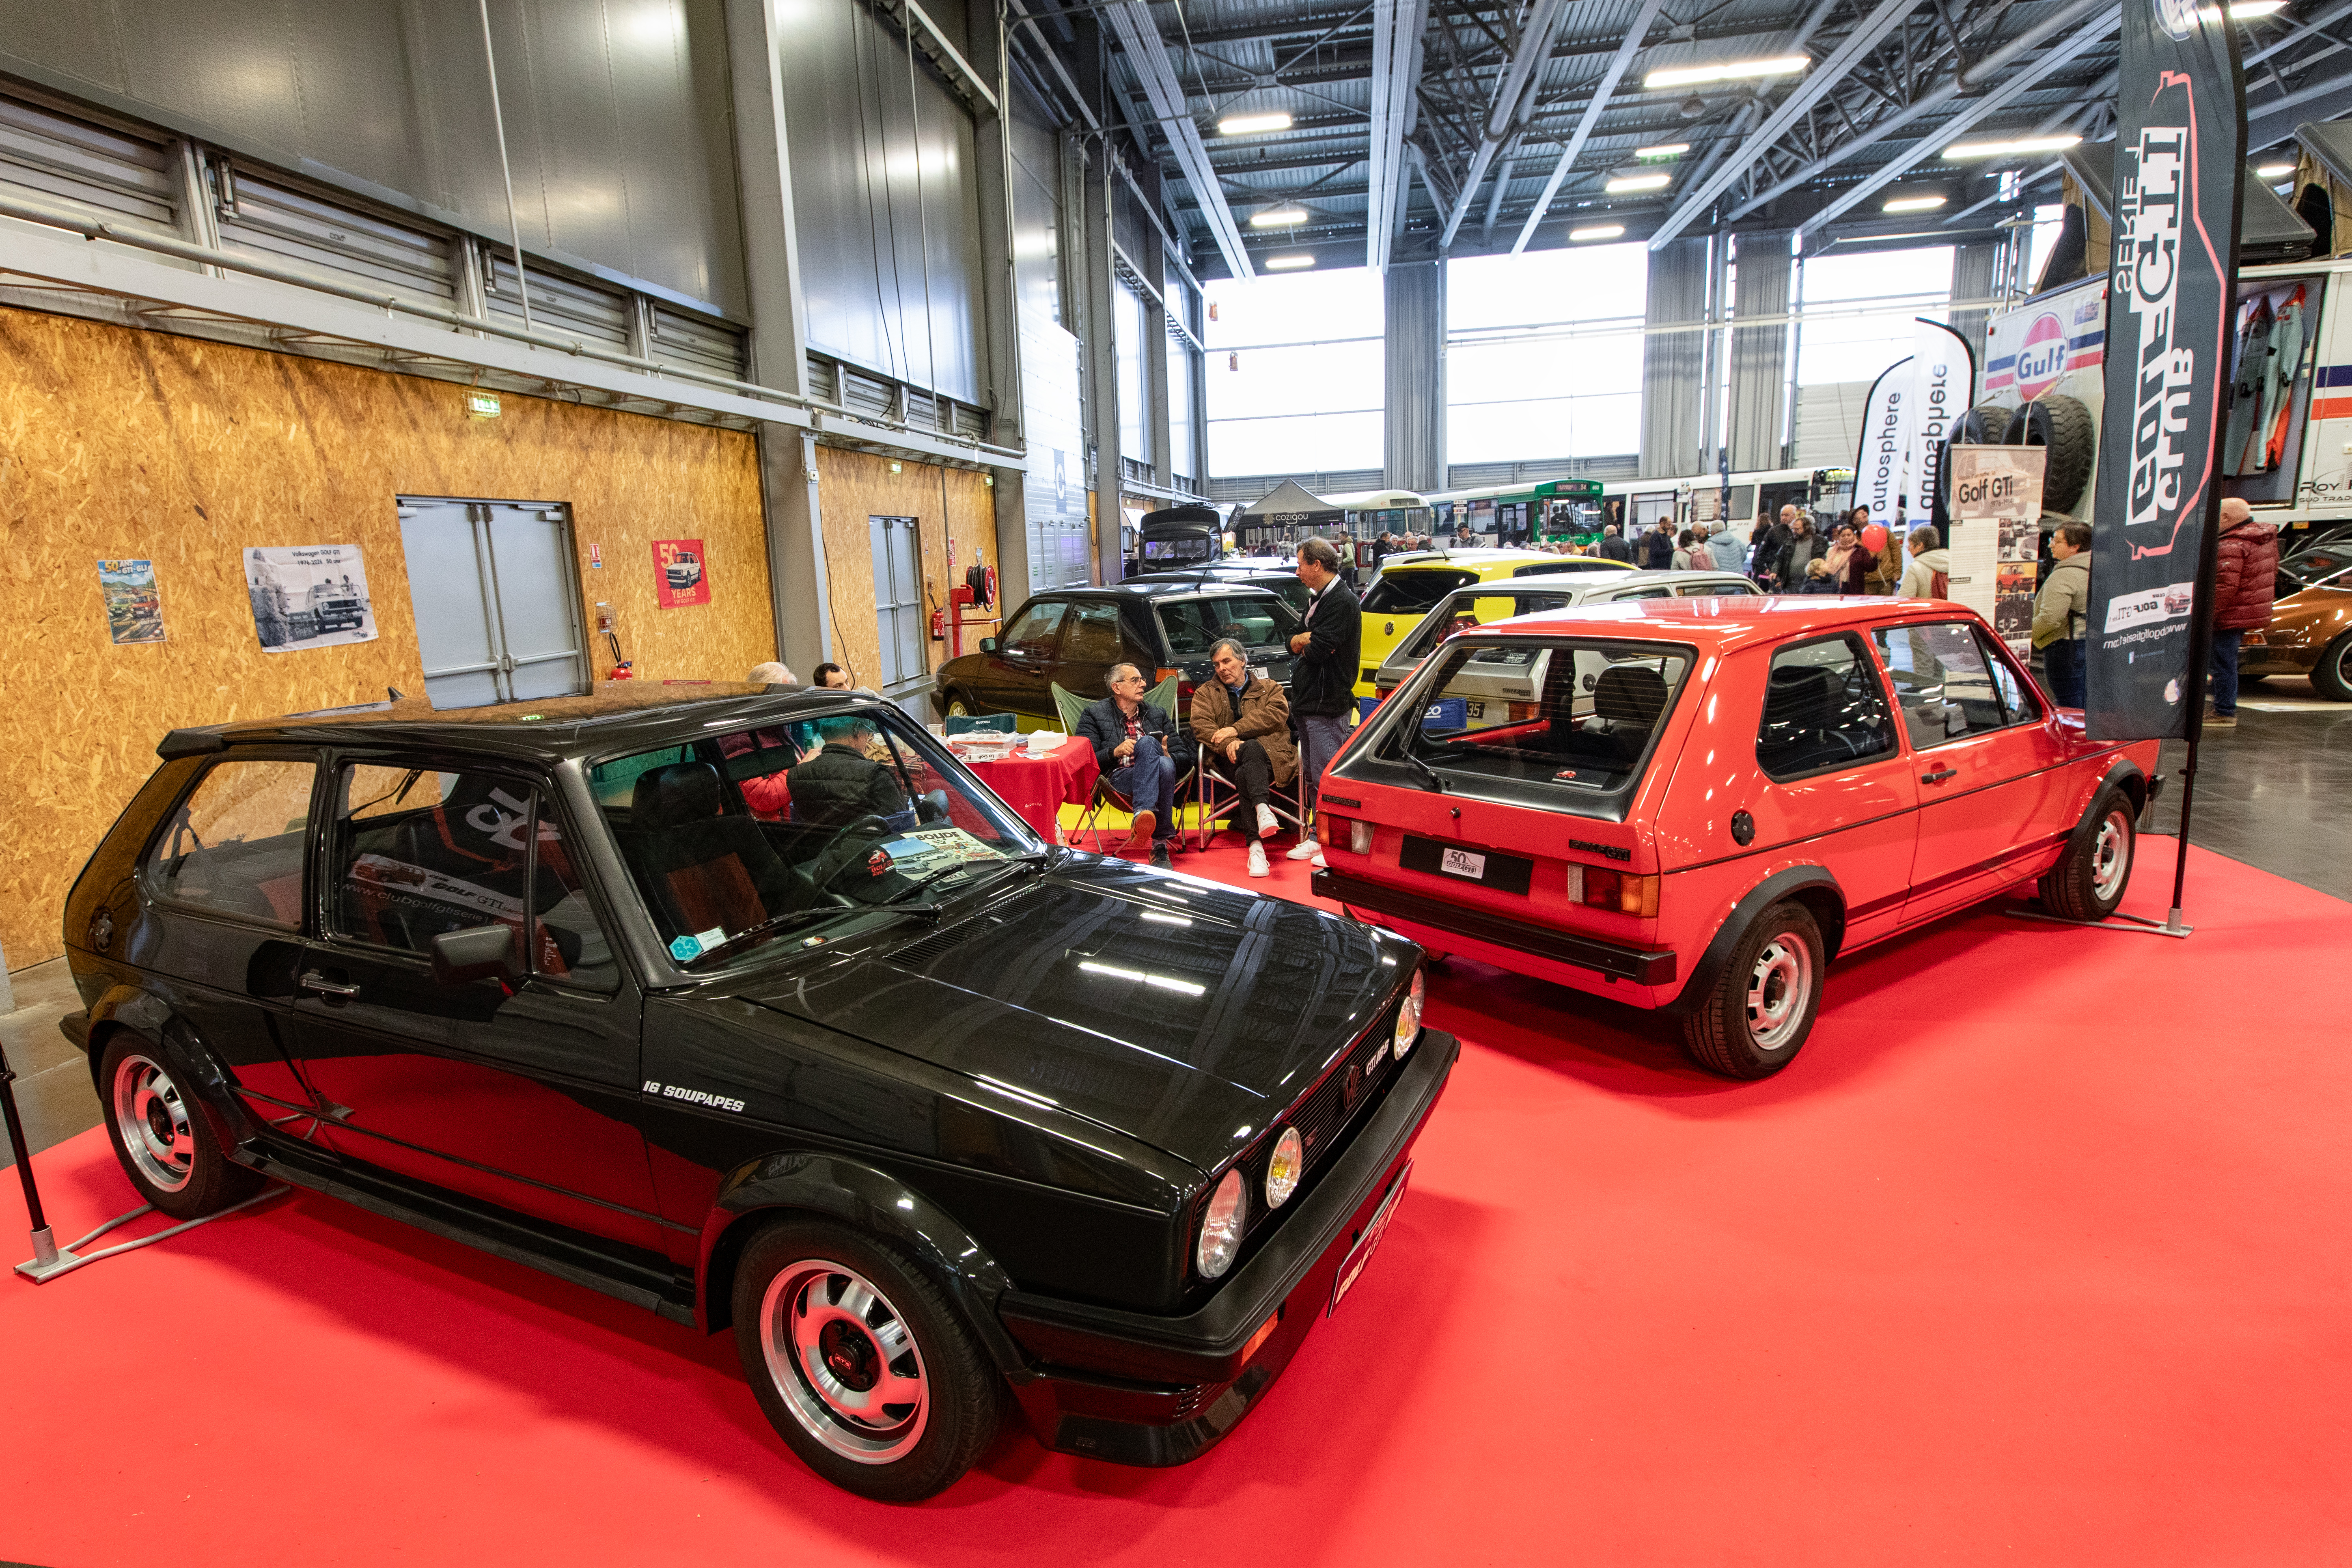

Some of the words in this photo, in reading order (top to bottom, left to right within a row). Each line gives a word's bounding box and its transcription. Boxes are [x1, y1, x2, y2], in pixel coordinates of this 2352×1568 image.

[2018, 345, 2065, 379] Gulf
[1873, 392, 1901, 512] autosphere
[1056, 464, 1065, 500] C
[2300, 481, 2340, 494] ROY
[1959, 478, 1988, 504] Golf
[1992, 475, 2013, 498] GTi
[1276, 514, 1308, 524] cozigou
[659, 544, 679, 569] 50
[105, 561, 119, 572] 50
[122, 566, 134, 574] GTI
[671, 587, 696, 599] YEARS
[1467, 703, 1481, 717] 35
[915, 832, 961, 841] BOLIDE
[1451, 851, 1466, 864] 50
[1606, 847, 1629, 861] GTI
[1447, 861, 1463, 869] GOLF
[1464, 865, 1476, 874] GTI
[431, 882, 476, 897] GOLF
[477, 895, 503, 910] GTI
[673, 938, 699, 958] 83
[643, 1081, 661, 1093] 16
[663, 1085, 745, 1112] SOUPAPES
